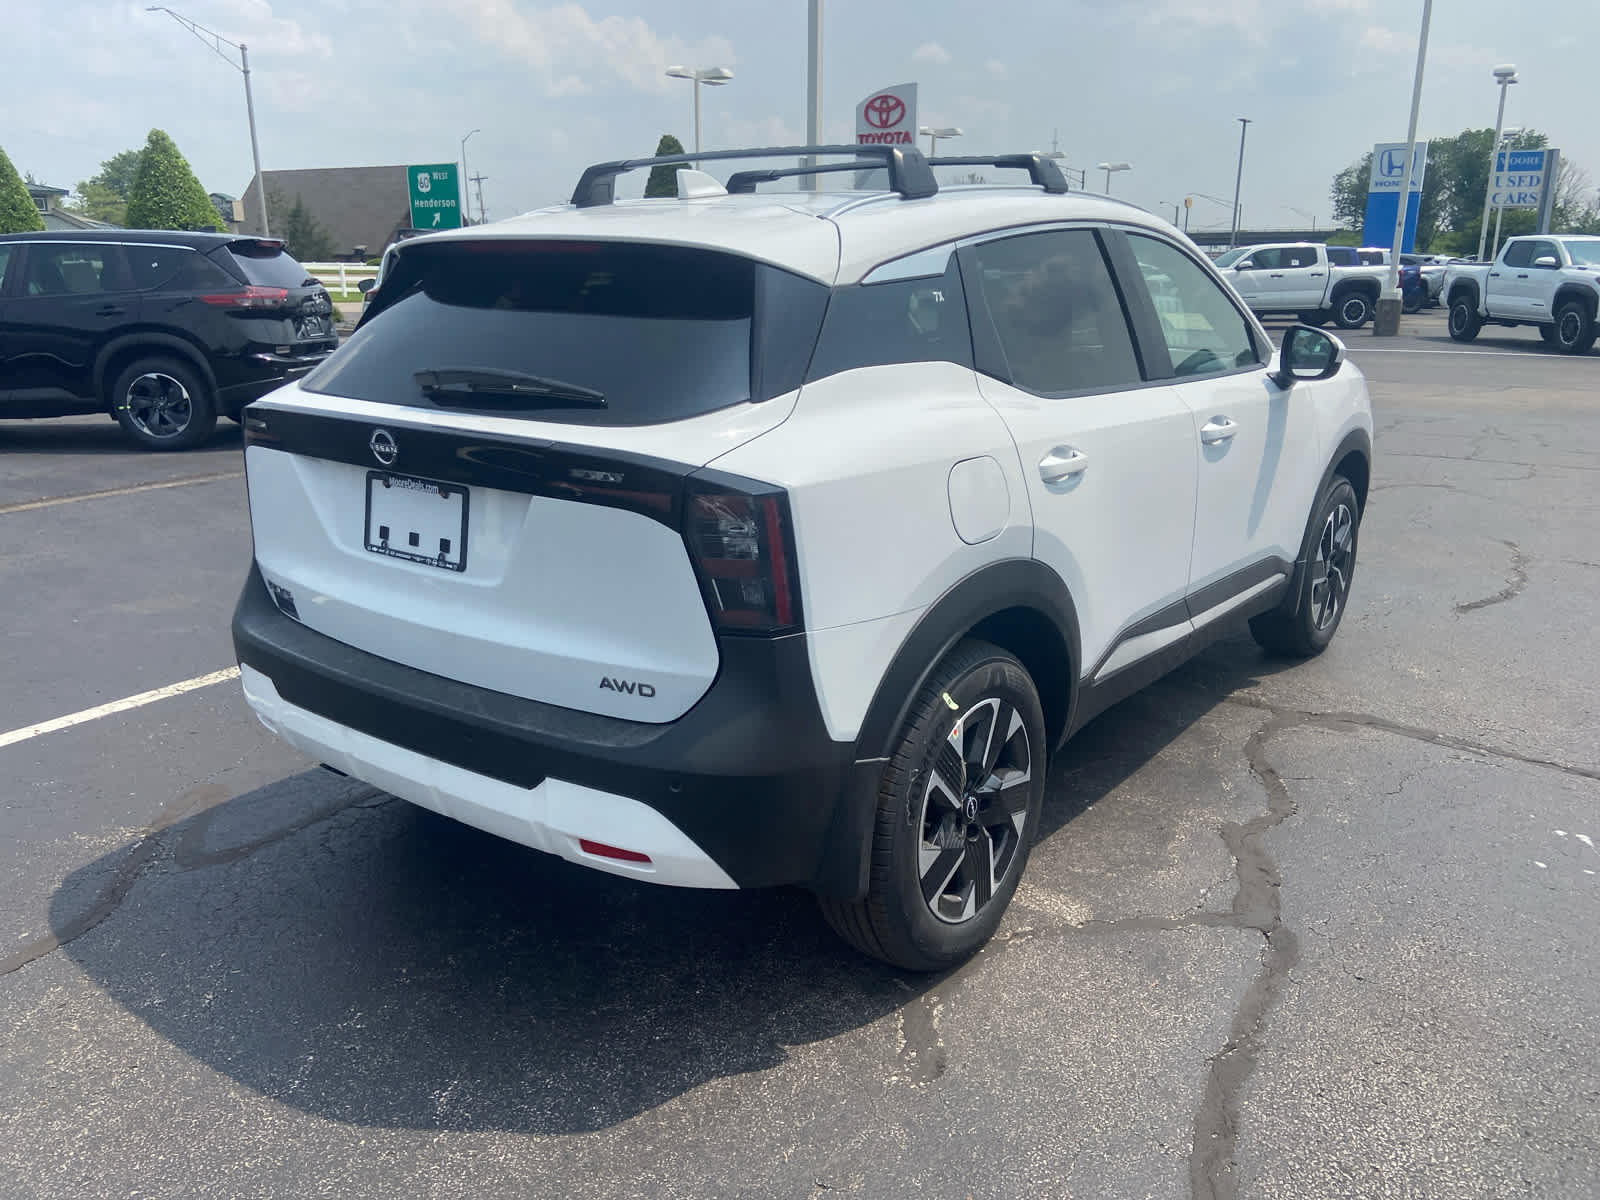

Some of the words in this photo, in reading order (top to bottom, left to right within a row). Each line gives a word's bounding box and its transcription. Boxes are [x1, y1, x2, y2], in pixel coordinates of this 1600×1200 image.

[857, 131, 912, 144] TOYOTA
[420, 177, 430, 189] 60
[415, 199, 456, 208] Henderson
[1491, 191, 1537, 205] CARS
[389, 476, 440, 495] MooreDeals.com
[599, 676, 656, 698] AWD
